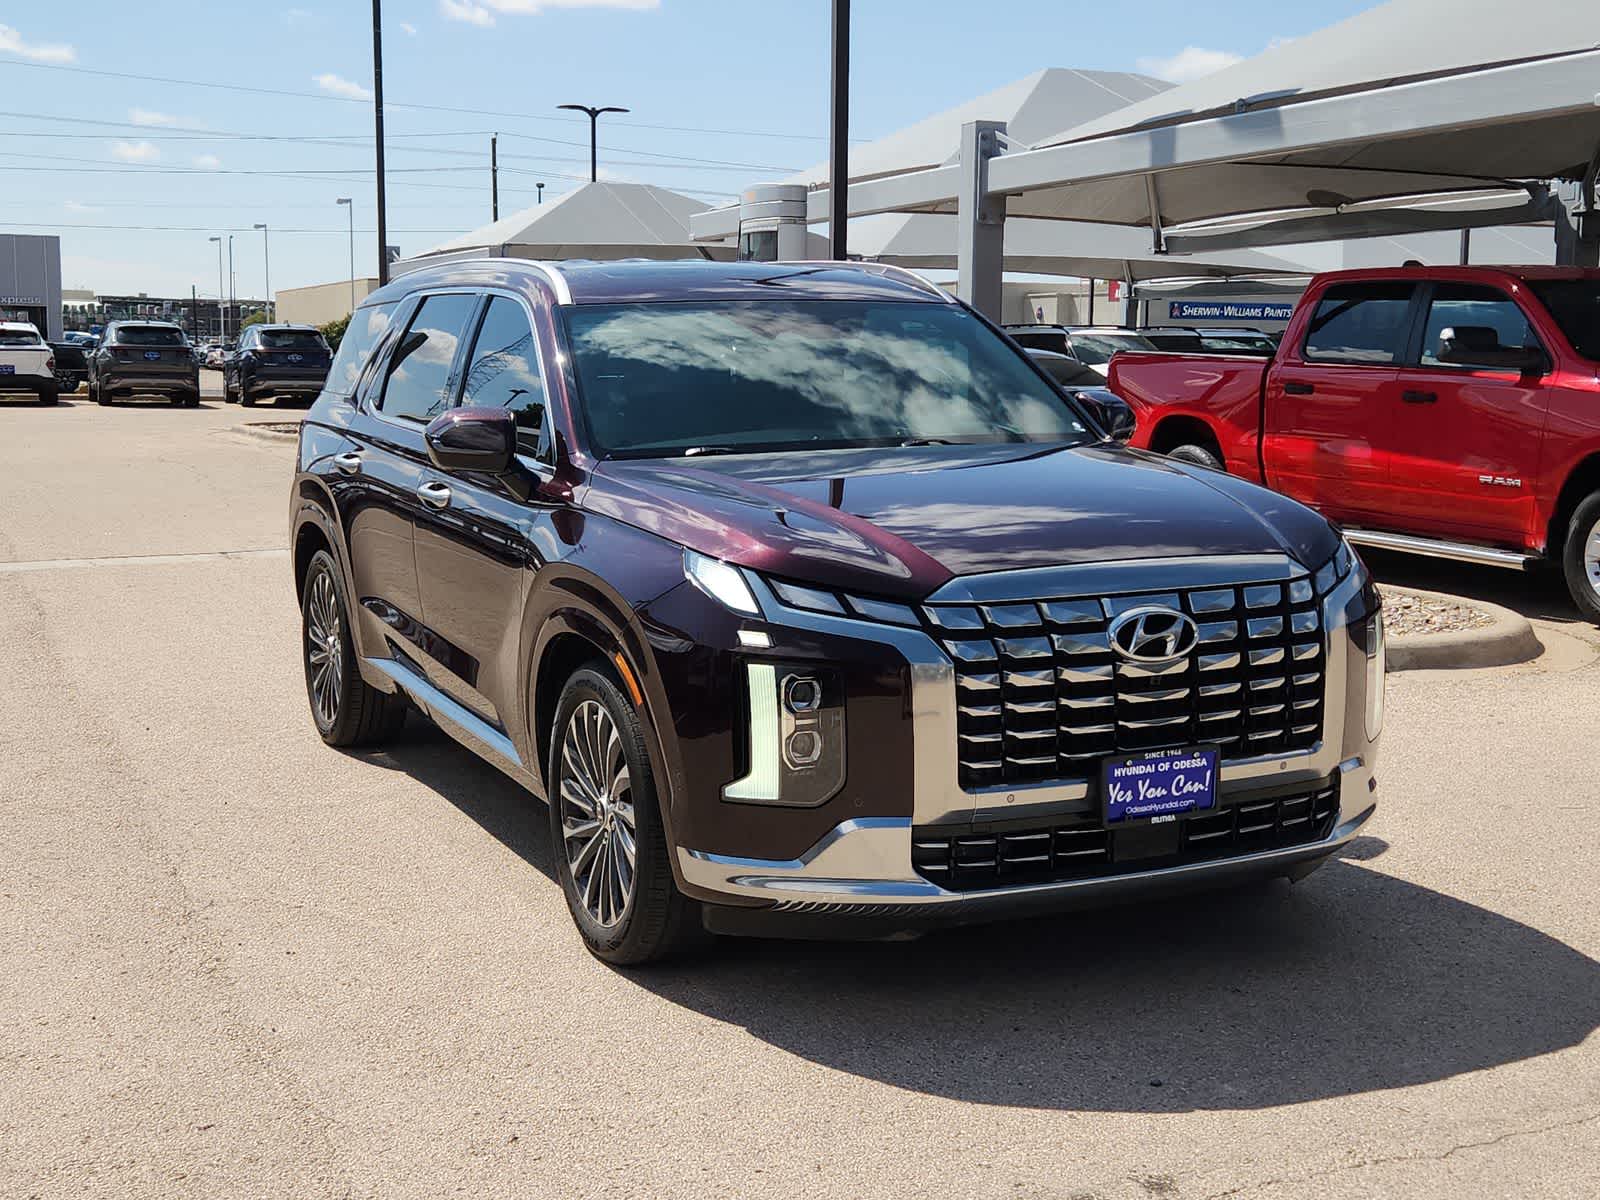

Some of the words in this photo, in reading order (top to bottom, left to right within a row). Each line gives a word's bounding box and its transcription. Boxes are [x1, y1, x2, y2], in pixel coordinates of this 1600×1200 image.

[1263, 306, 1293, 318] PAINTS
[1479, 475, 1521, 487] RAM
[1144, 750, 1166, 760] SINCE
[1114, 764, 1155, 777] HYUNDAI
[1157, 762, 1171, 772] OF
[1172, 758, 1208, 770] ODESSA
[1108, 781, 1133, 805] Yes
[1138, 778, 1168, 801] You
[1171, 769, 1211, 797] Can!
